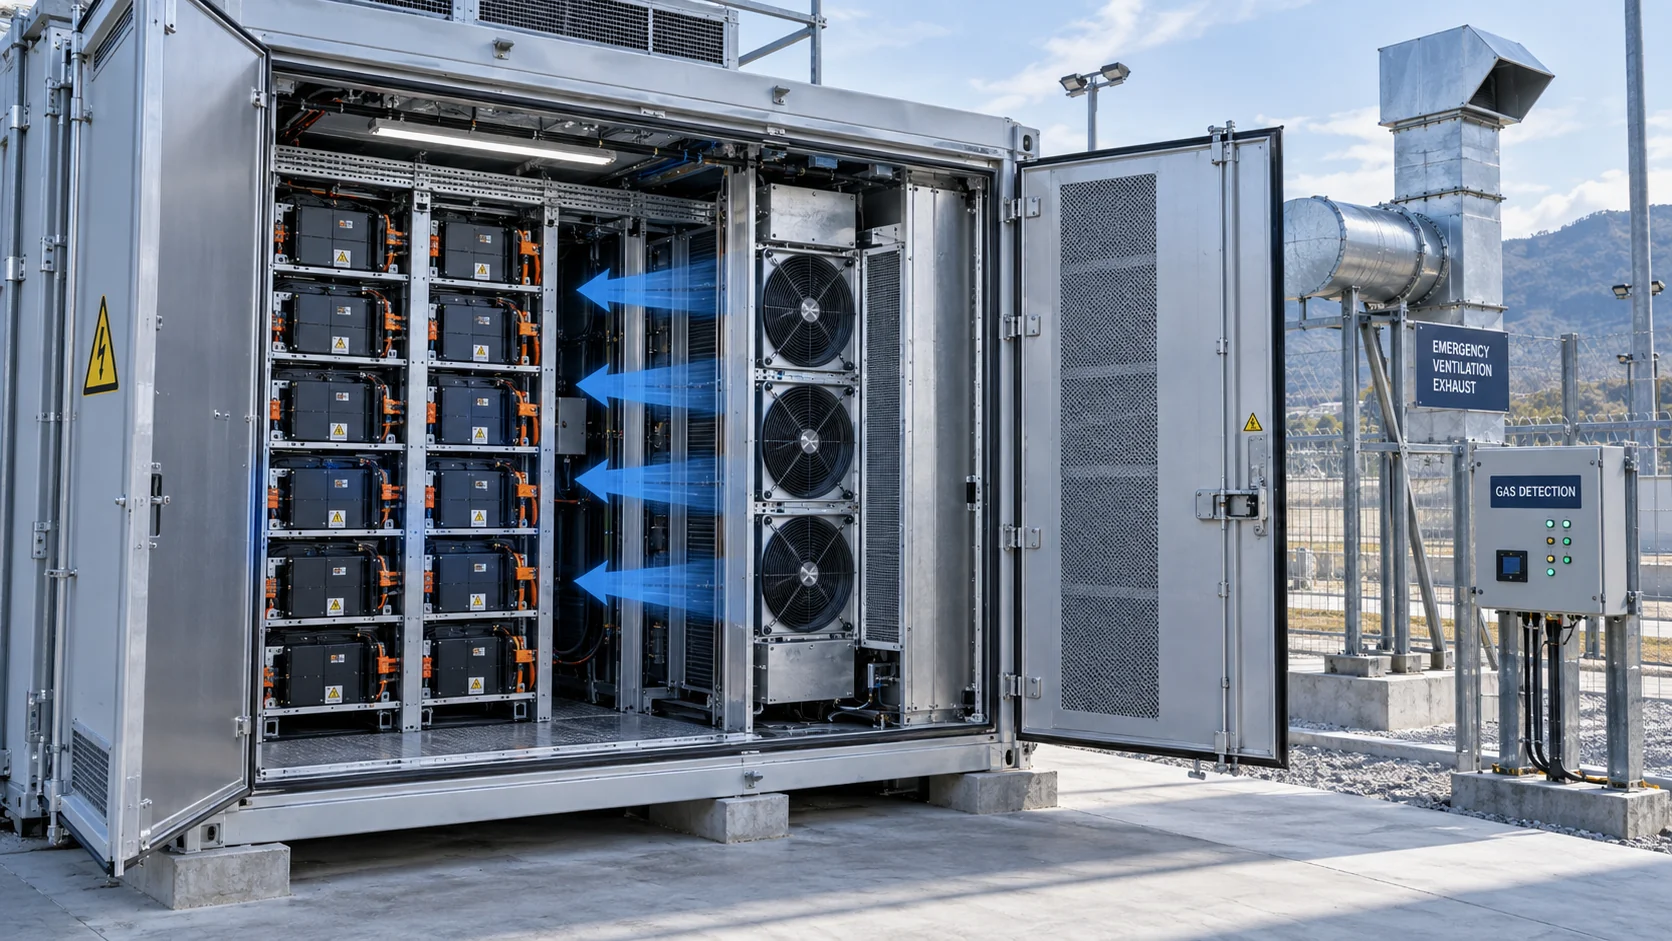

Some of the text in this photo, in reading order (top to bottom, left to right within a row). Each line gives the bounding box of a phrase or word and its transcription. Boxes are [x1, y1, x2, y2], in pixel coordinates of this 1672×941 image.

[1432, 340, 1490, 358] EMERGENCY
[1432, 359, 1493, 376] VENTILATION
[1433, 378, 1477, 394] EXHAUST
[1495, 485, 1576, 498] GAS DETECTION
